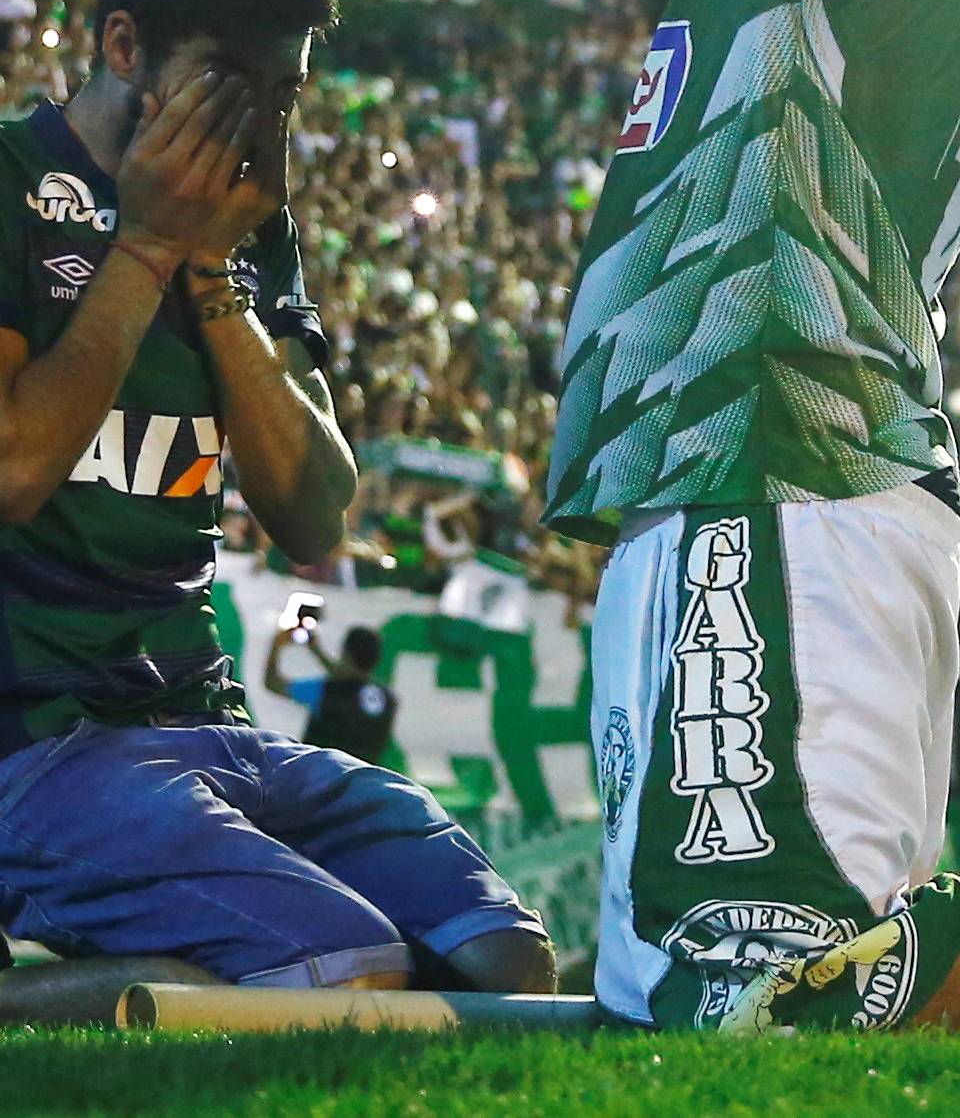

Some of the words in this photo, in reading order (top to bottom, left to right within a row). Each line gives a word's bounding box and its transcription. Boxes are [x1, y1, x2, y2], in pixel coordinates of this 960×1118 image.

[67, 409, 222, 497] AIX
[672, 515, 776, 865] GARRA
[852, 954, 901, 1029] 2009
